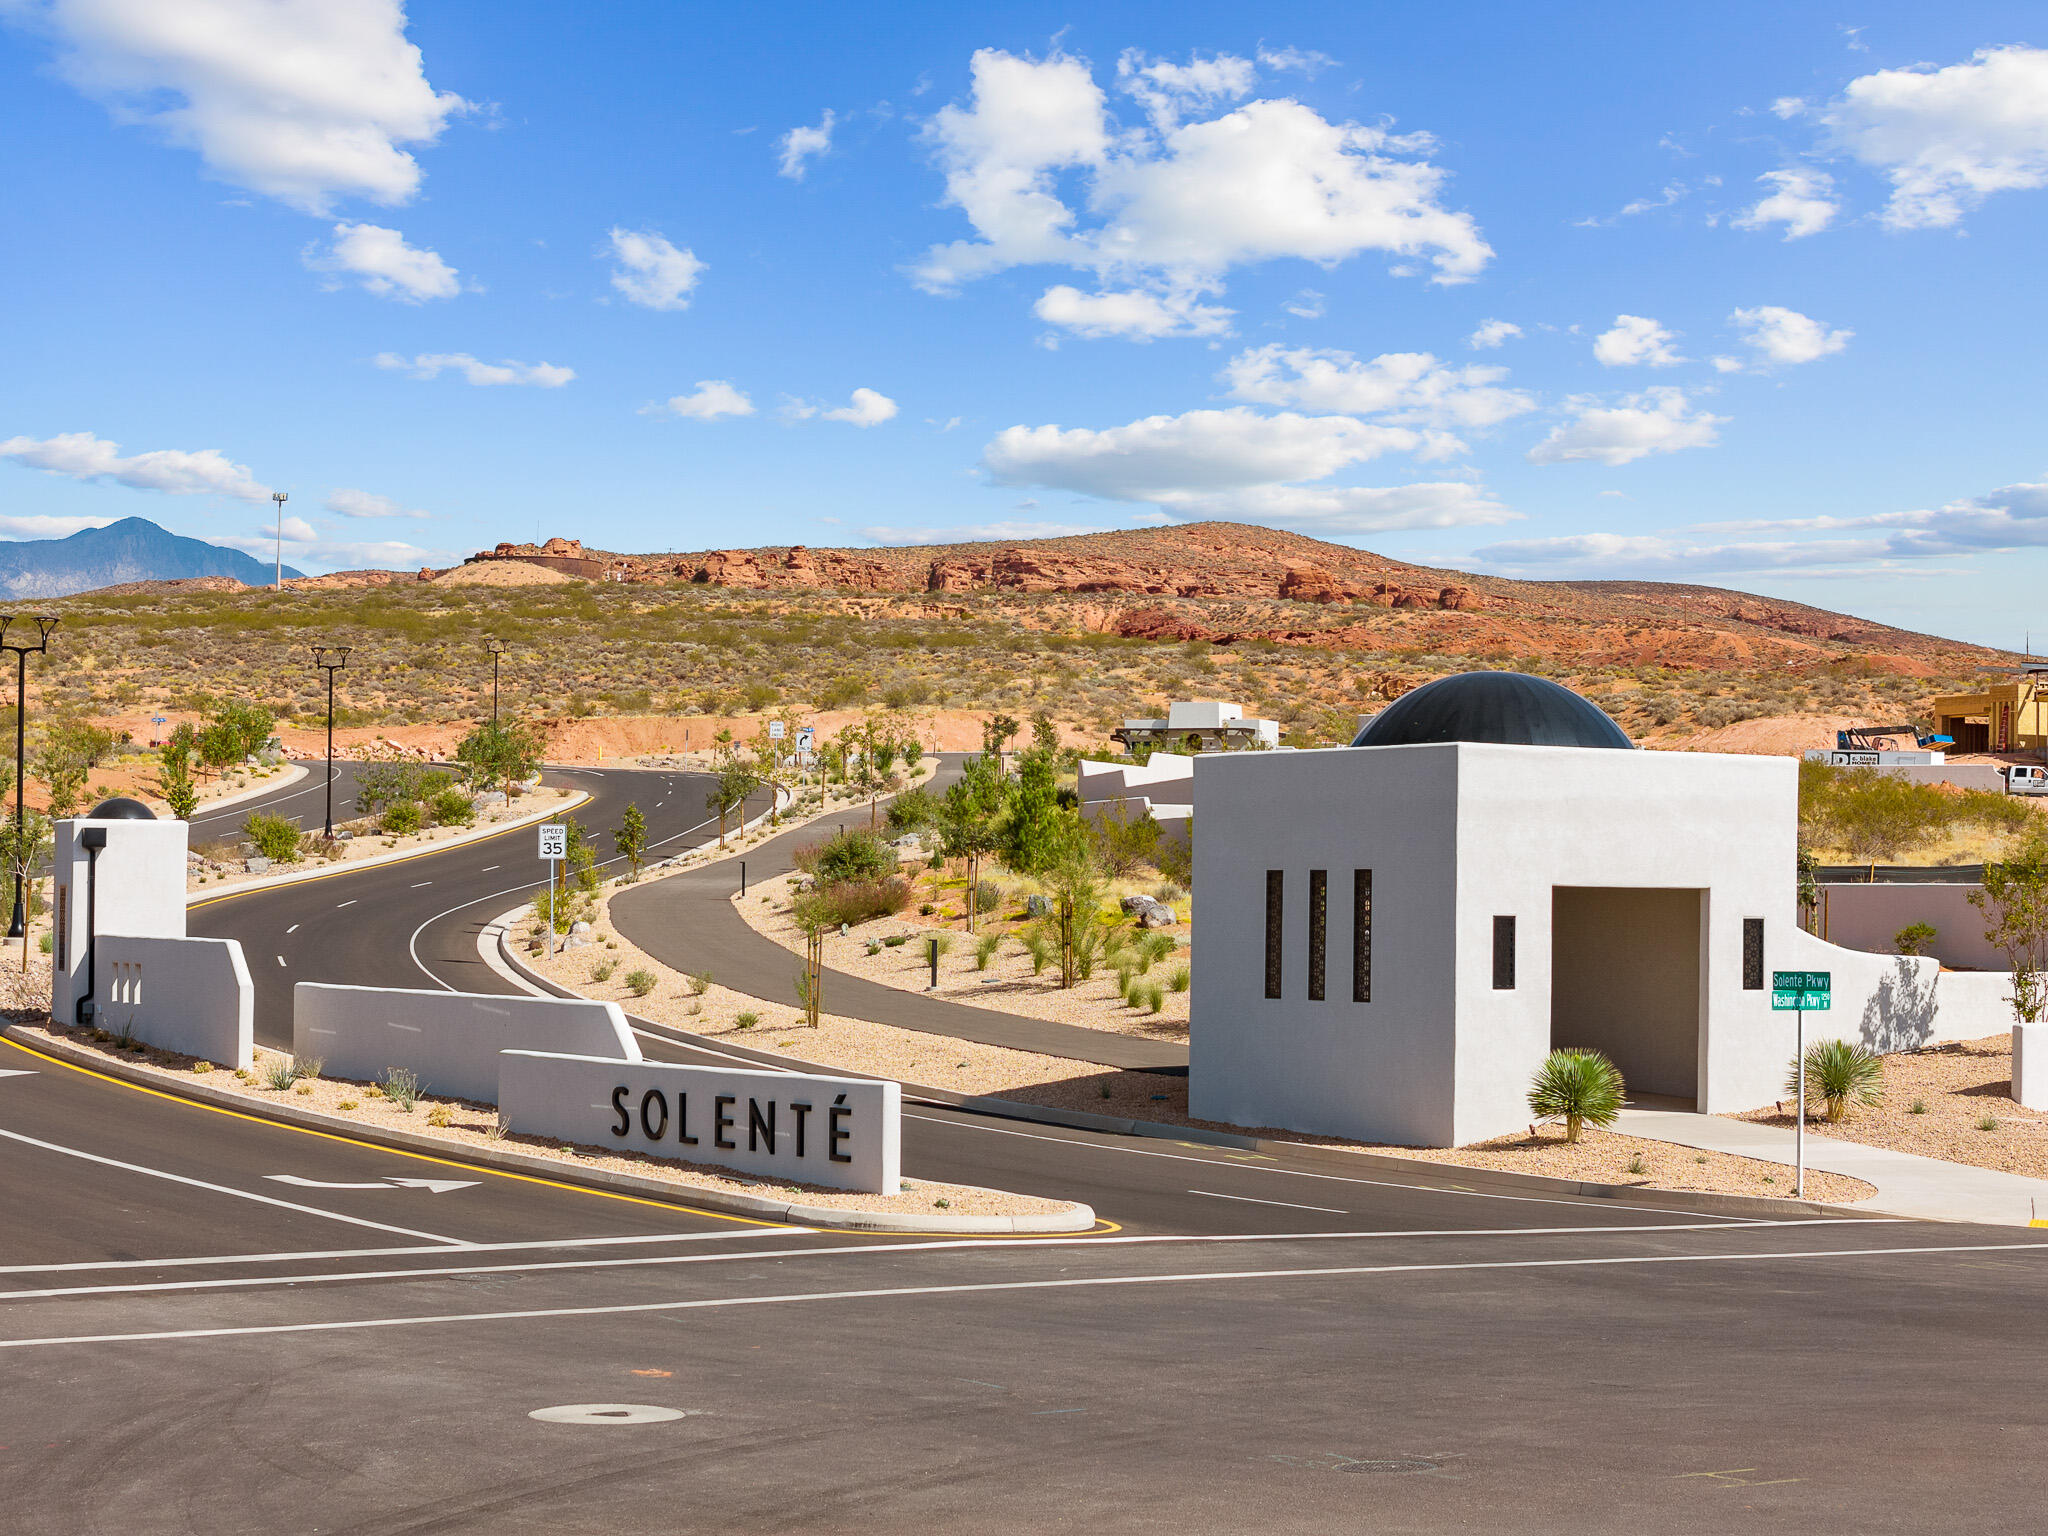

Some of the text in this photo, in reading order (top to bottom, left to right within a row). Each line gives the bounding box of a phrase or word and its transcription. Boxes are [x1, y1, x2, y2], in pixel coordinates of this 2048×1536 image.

[543, 842, 562, 854] 35
[1773, 974, 1830, 991] Solente Pkwy
[1773, 993, 1805, 1007] Washinn
[610, 1085, 852, 1163] SOLENTÉ
